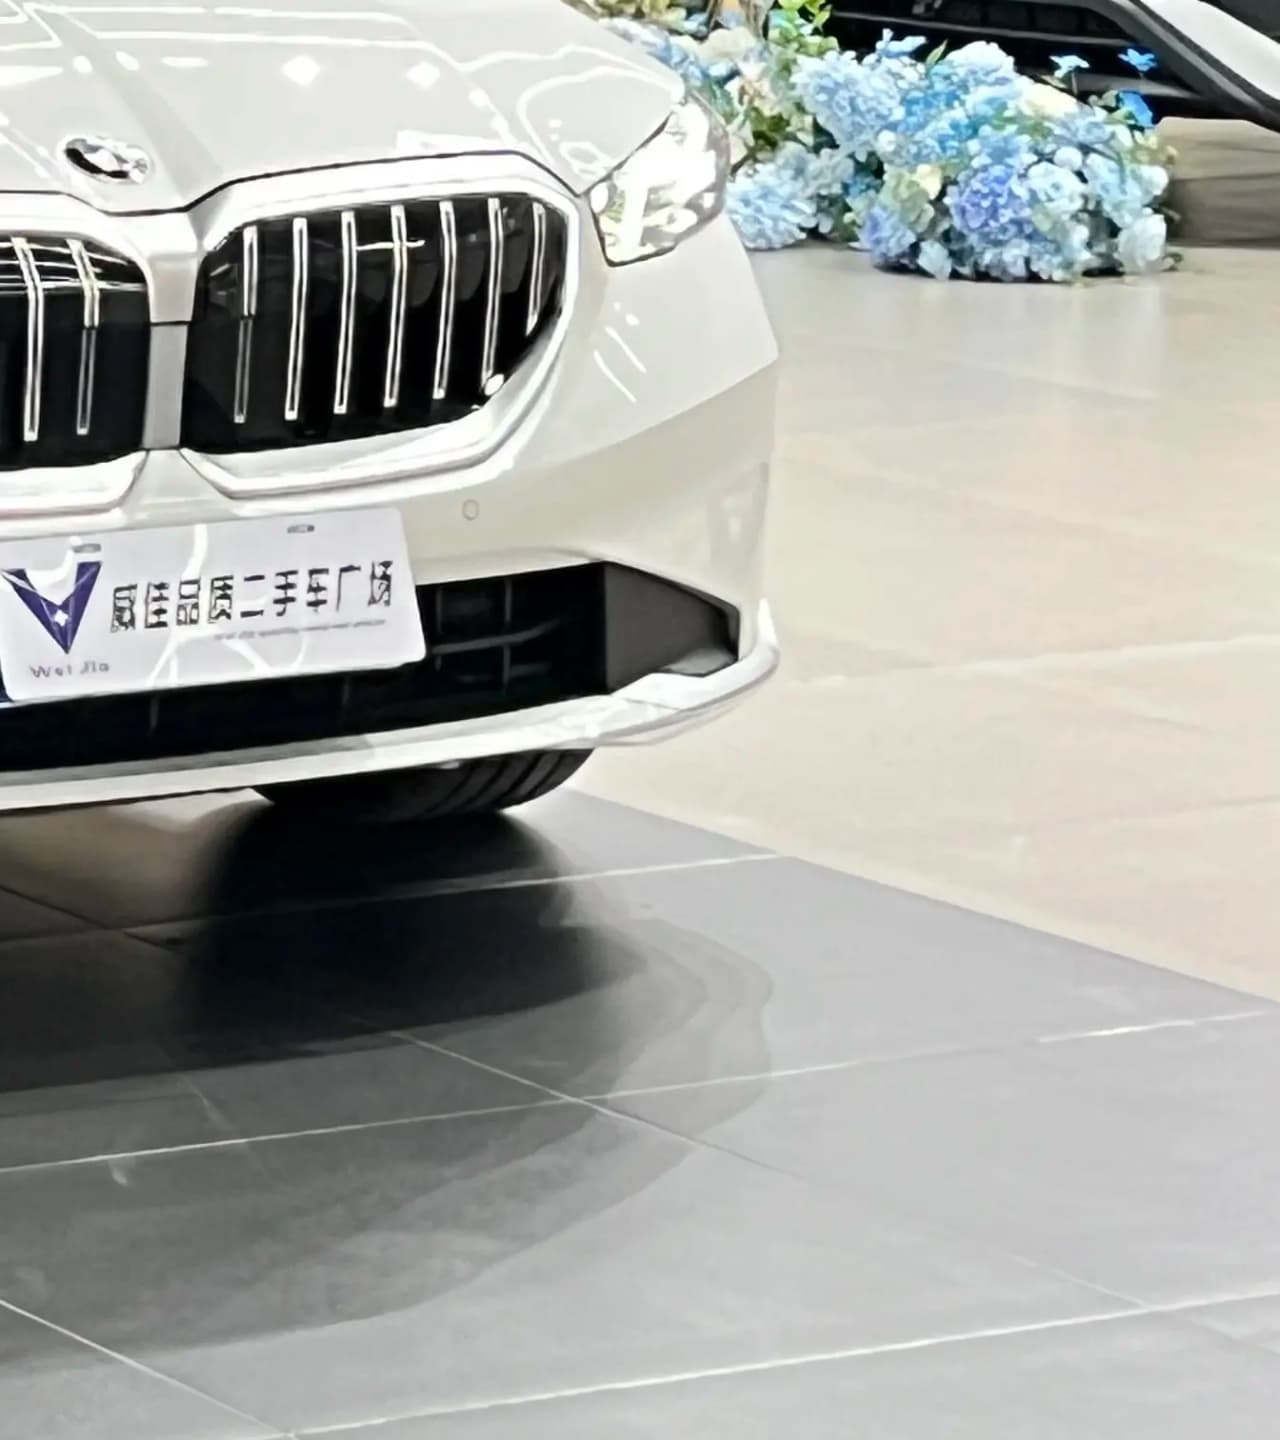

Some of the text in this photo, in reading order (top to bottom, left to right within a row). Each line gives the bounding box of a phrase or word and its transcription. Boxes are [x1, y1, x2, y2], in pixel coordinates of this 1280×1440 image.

[110, 561, 393, 632] 威佳品质二手车广场
